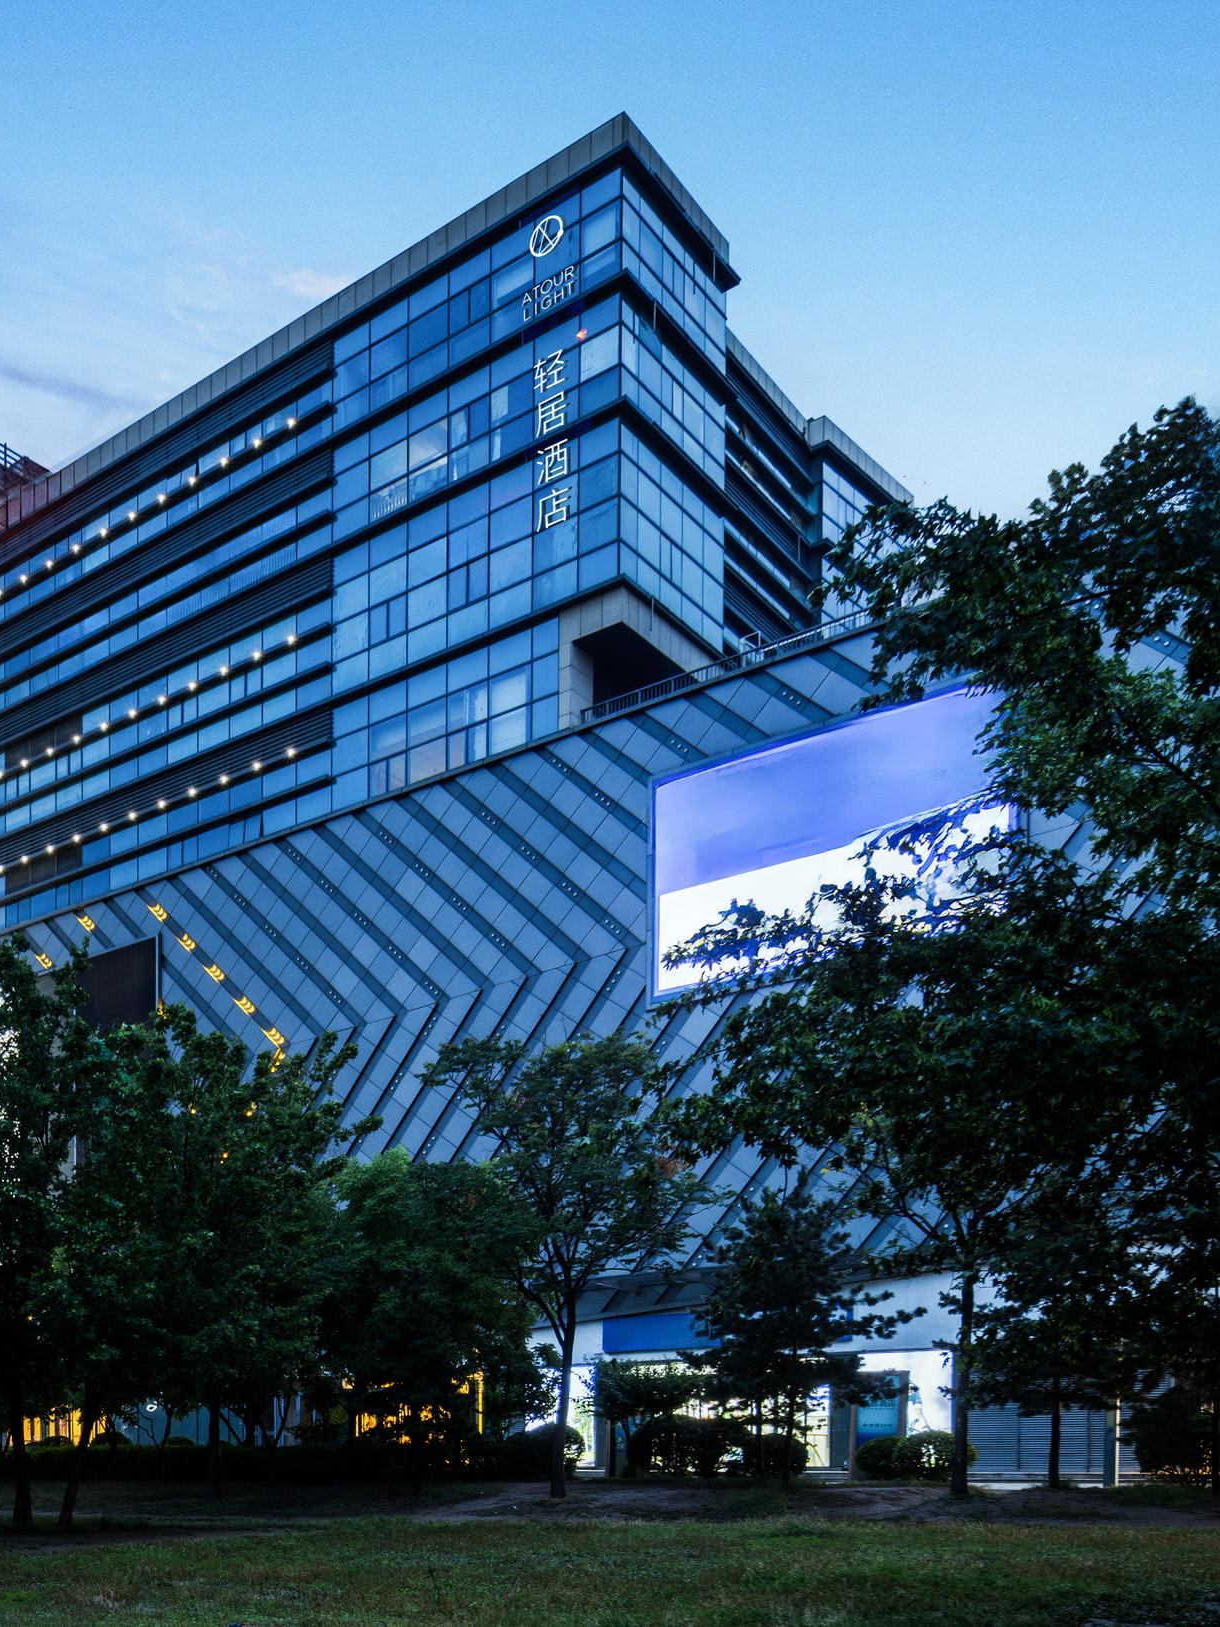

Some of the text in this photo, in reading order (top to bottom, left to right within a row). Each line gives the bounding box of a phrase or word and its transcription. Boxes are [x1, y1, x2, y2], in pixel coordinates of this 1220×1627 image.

[521, 265, 574, 307] ATOUR
[523, 280, 575, 322] LIGHT
[533, 349, 569, 532] 轻居酒店
